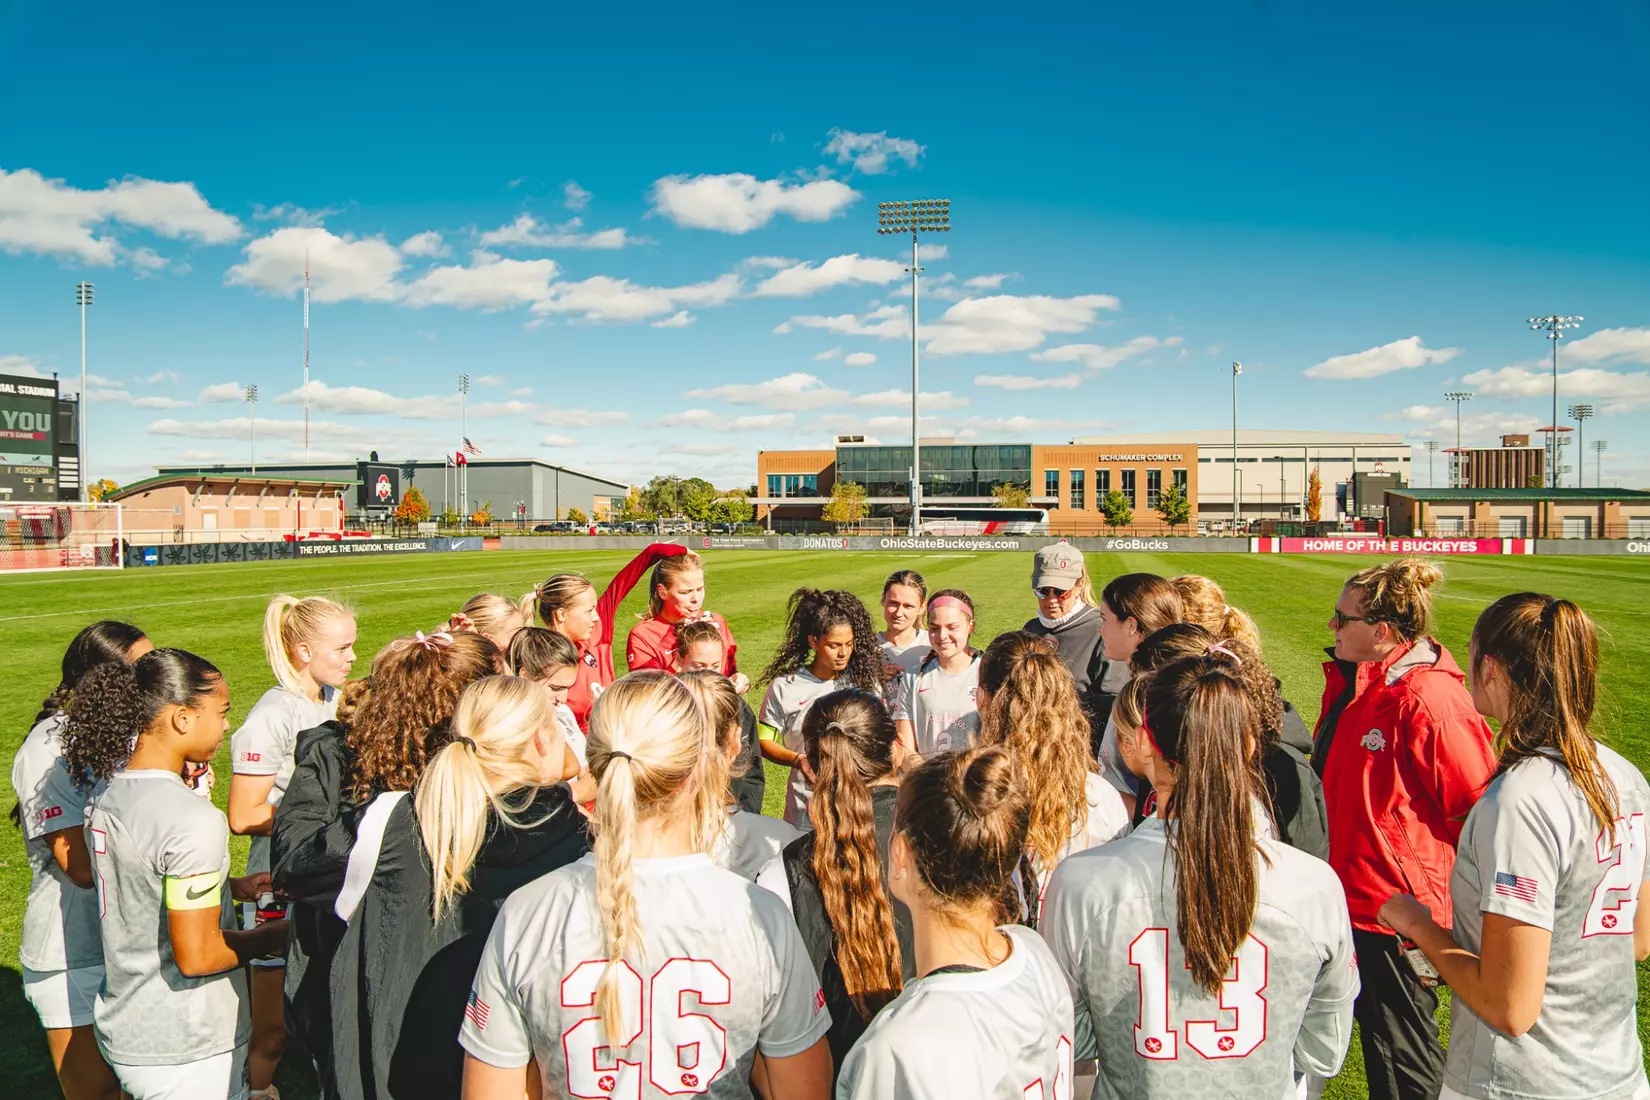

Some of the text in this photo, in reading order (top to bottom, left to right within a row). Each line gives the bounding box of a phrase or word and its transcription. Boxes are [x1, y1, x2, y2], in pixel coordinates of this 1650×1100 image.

[17, 385, 56, 398] STADIUM
[1, 410, 51, 432] YOU
[1099, 453, 1183, 462] SCHUMAKER COMPLEX
[300, 545, 313, 555] THE
[339, 544, 351, 553] THE
[383, 543, 395, 551] THE
[803, 538, 842, 550] DONATOS
[880, 538, 1019, 551] OhioStateBuckeyes.com
[1106, 539, 1169, 551] #GoBucks
[1303, 540, 1343, 551] HOME
[1346, 540, 1365, 551] OF
[1402, 541, 1478, 553] BUCKEYES
[1128, 927, 1269, 1061] 13
[560, 956, 732, 1100] 26
